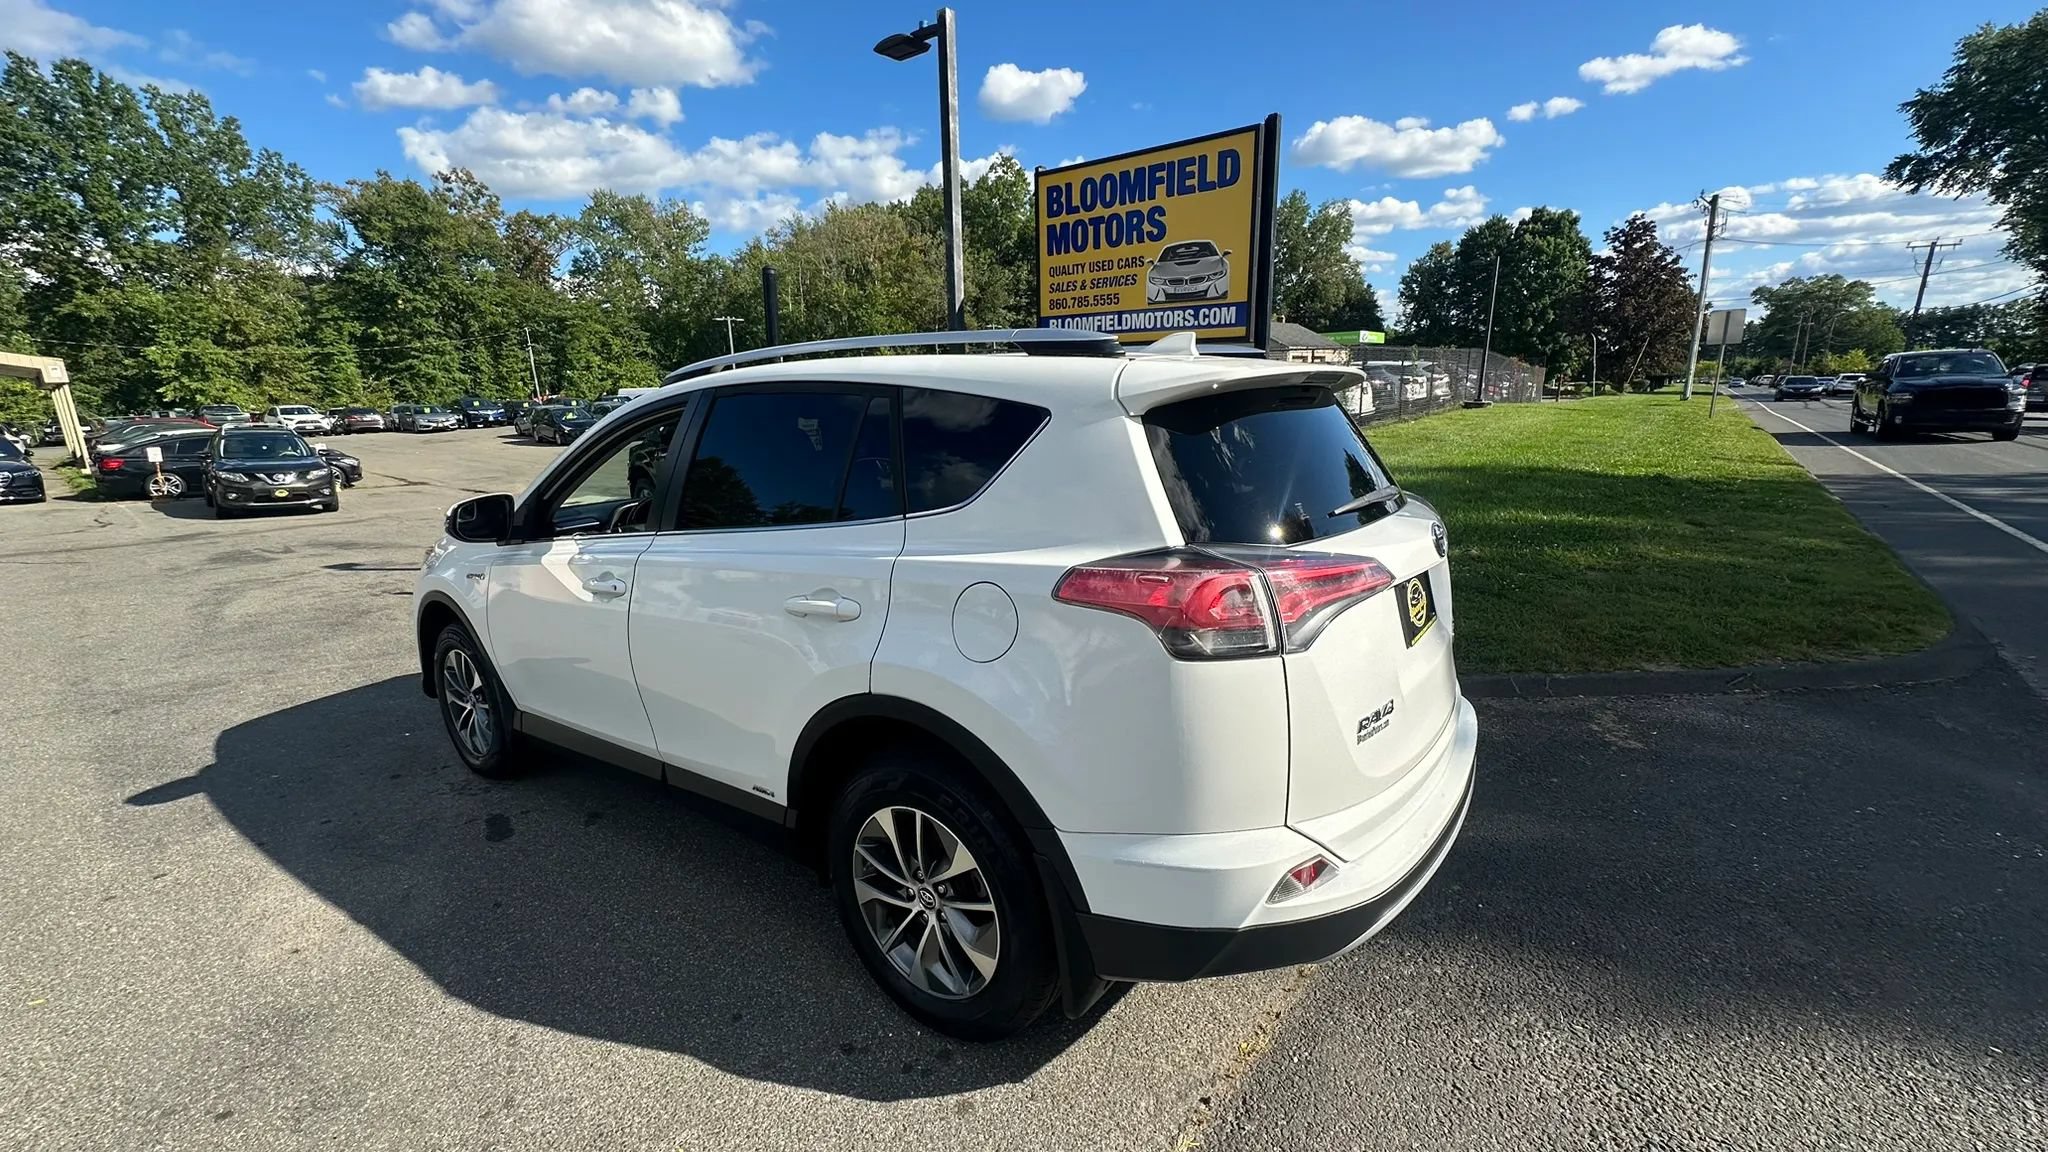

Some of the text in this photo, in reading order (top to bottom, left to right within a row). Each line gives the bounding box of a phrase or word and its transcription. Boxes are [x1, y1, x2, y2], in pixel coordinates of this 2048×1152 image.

[1046, 149, 1241, 218] BLOOMFIELD
[1047, 205, 1167, 256] MOTORS
[1049, 256, 1145, 278] QUALITY USED CARS
[1049, 274, 1138, 294] SALES & SERVICES
[1049, 293, 1120, 310] 860.785.5555
[1049, 307, 1236, 332] BLOOMFIELDMOTORS.COM
[1357, 699, 1394, 734] RAV4
